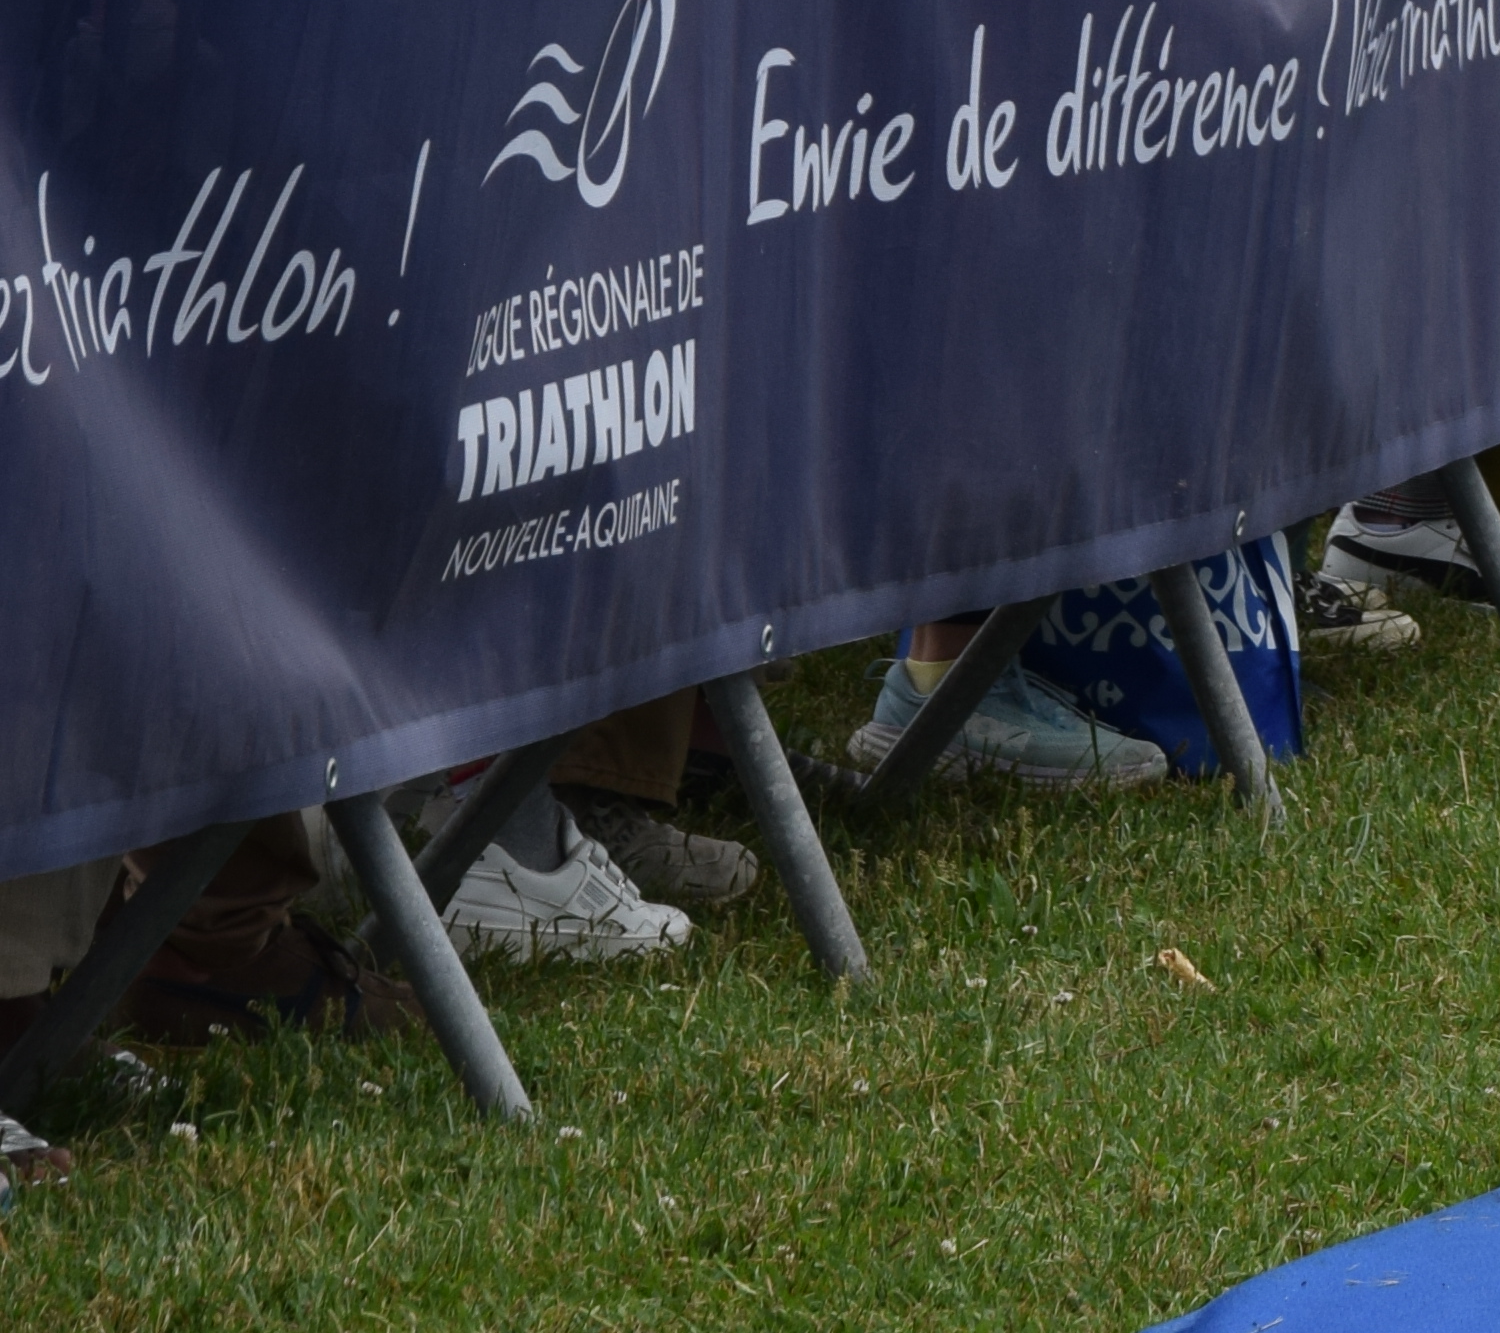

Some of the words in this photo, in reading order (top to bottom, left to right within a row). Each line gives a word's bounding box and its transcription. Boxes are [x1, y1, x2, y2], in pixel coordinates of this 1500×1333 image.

[748, 47, 916, 225] Envie
[945, 24, 1019, 191] de
[1046, 1, 1299, 179] différence
[38, 163, 356, 373] triathlon
[388, 139, 431, 327] !
[466, 294, 525, 378] LIGUE
[529, 253, 673, 356] RÉGIONALE
[678, 244, 705, 313] DE
[457, 338, 695, 503] TRIATHLON
[441, 478, 680, 582] NOUVELLE-AQUITAINE
